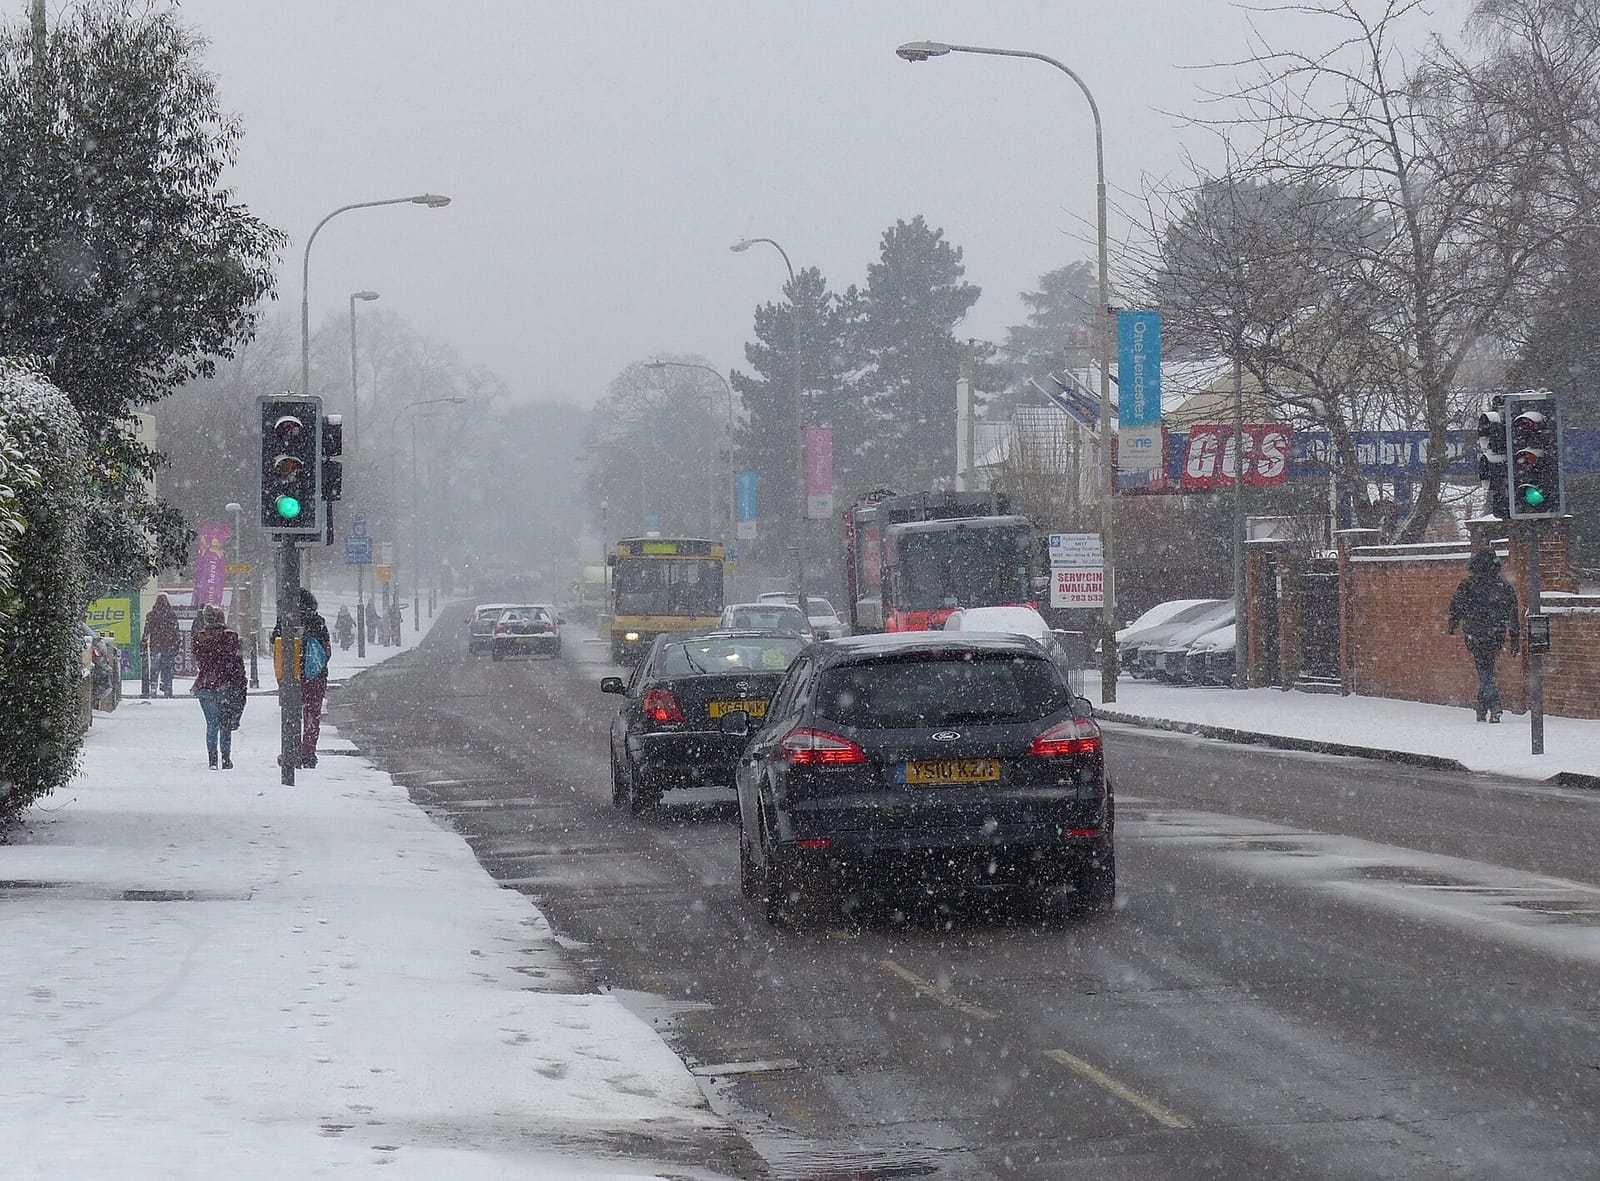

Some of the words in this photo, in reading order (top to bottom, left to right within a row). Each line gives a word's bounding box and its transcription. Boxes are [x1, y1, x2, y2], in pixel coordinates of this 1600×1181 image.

[1134, 321, 1147, 351] One
[1134, 355, 1147, 419] Leicester
[1058, 573, 1103, 582] SERVICIN
[1059, 583, 1103, 592] AVAILABL
